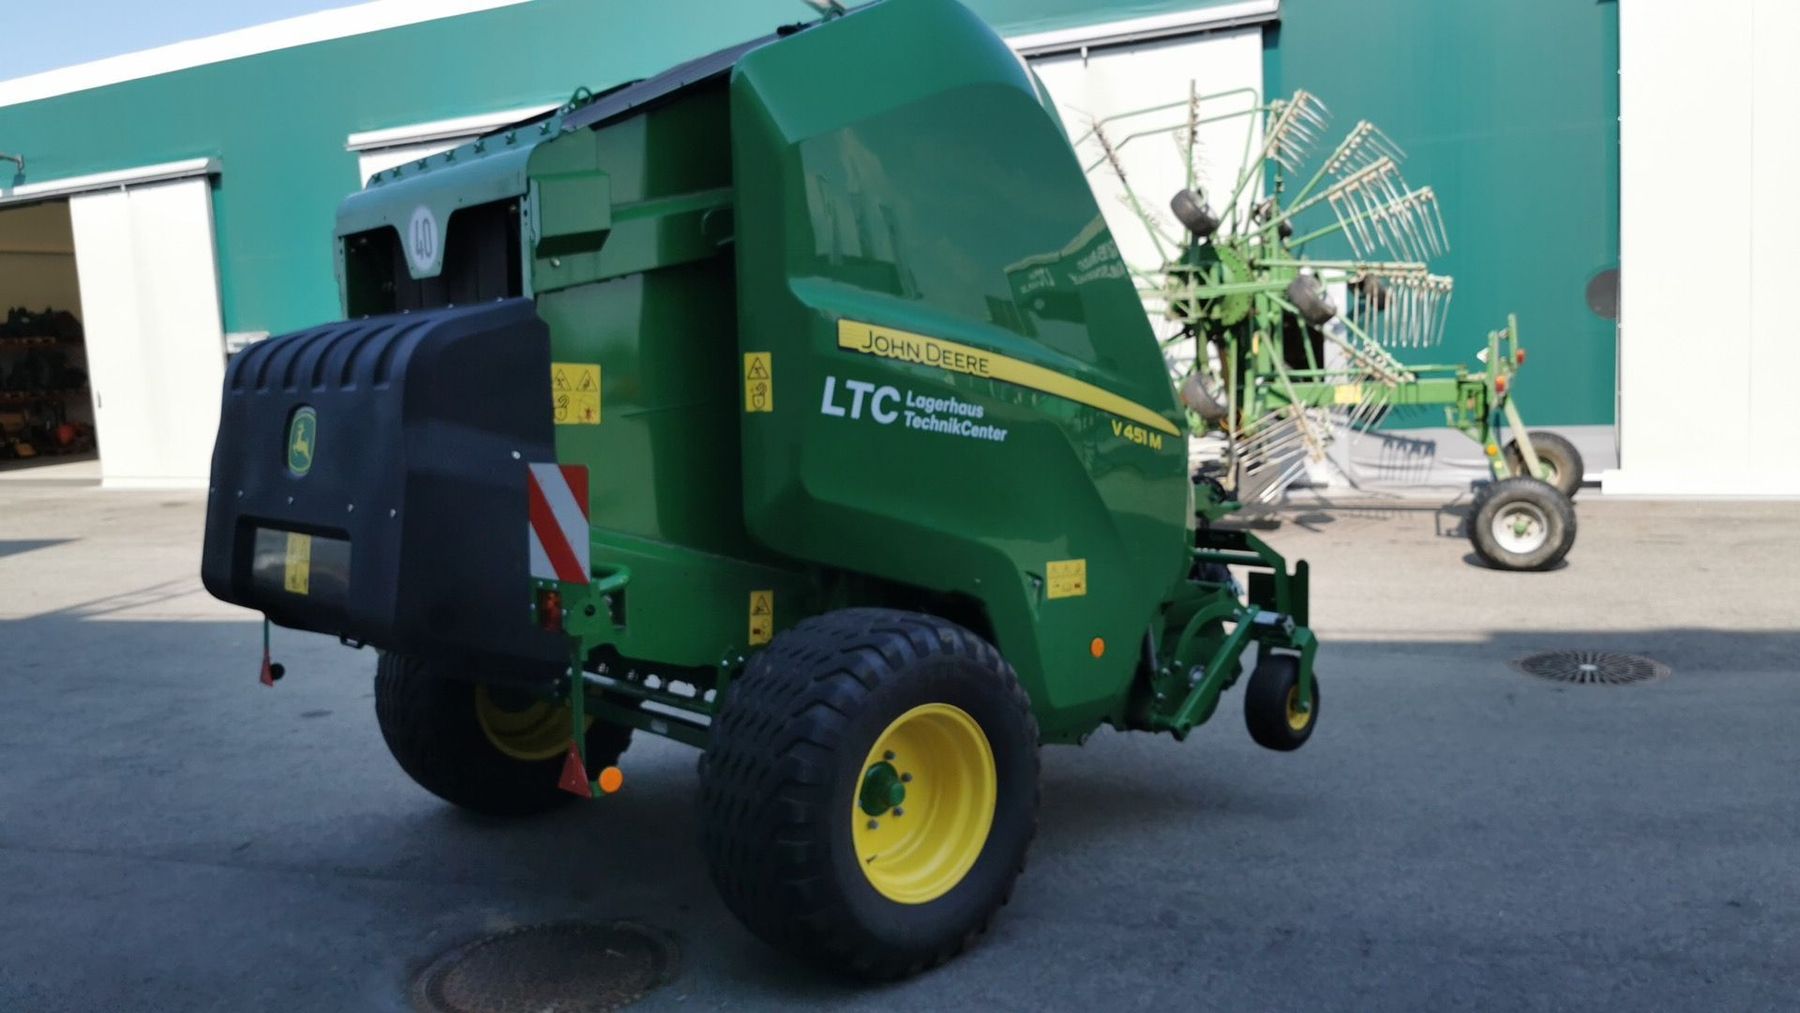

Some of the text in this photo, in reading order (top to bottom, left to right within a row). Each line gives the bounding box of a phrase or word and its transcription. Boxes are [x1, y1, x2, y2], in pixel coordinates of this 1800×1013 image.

[415, 217, 432, 260] 40
[862, 330, 990, 374] JOHN DEERE
[820, 375, 901, 425] LTC
[905, 390, 984, 419] Lagerhaus
[904, 410, 1008, 442] TechnikCenter
[1111, 418, 1162, 450] V 451 M
